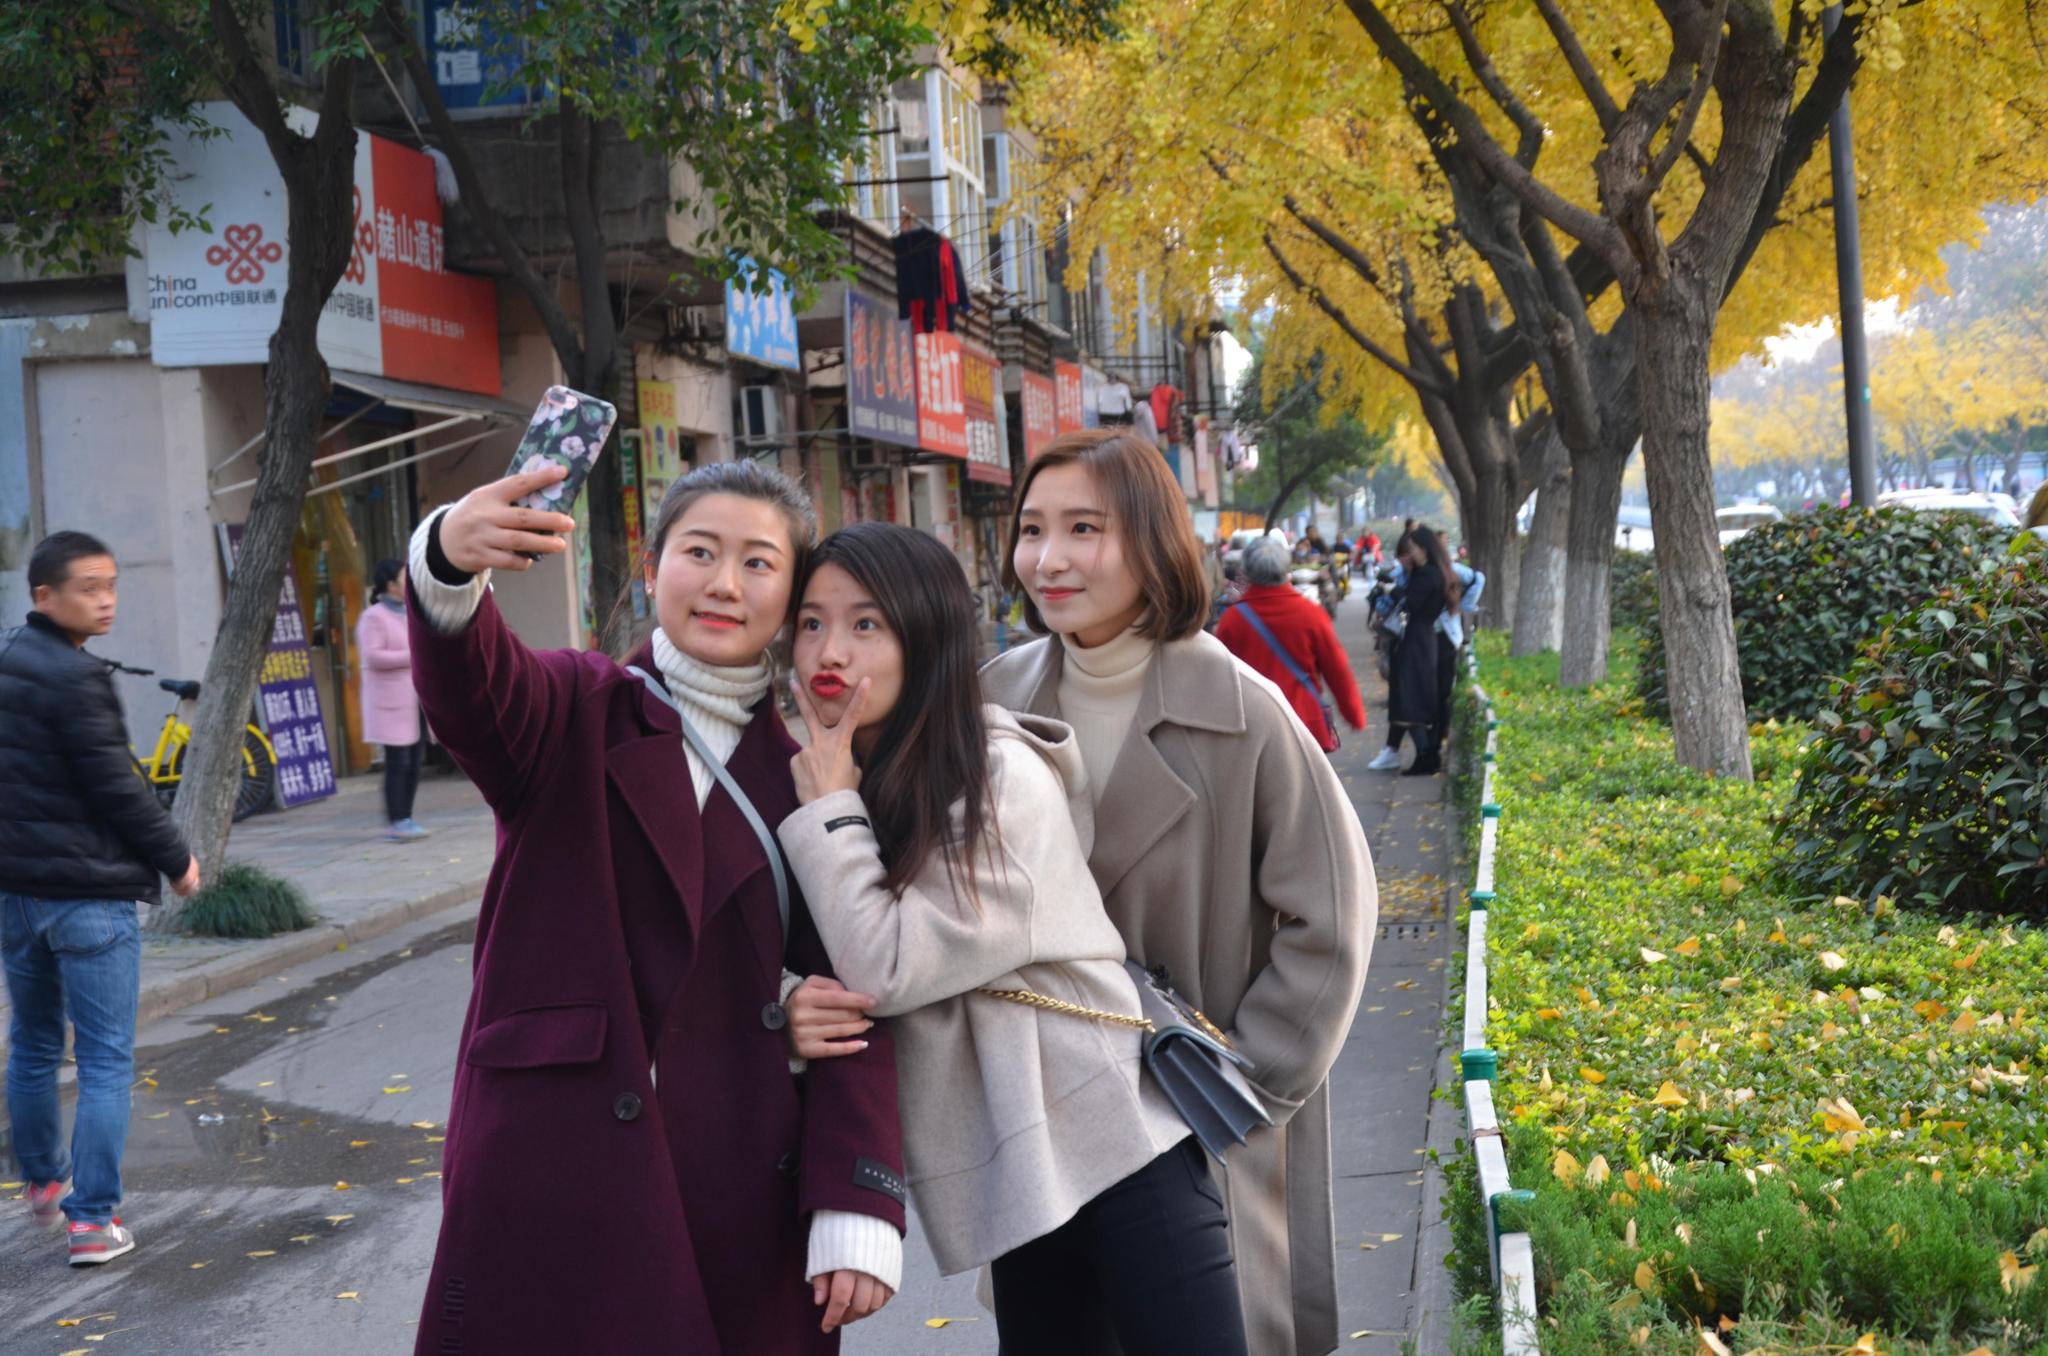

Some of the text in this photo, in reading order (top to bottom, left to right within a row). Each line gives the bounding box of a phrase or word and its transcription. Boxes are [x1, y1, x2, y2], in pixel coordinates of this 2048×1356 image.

[215, 288, 277, 306] 中国联通
[336, 291, 374, 322] 中国联通
